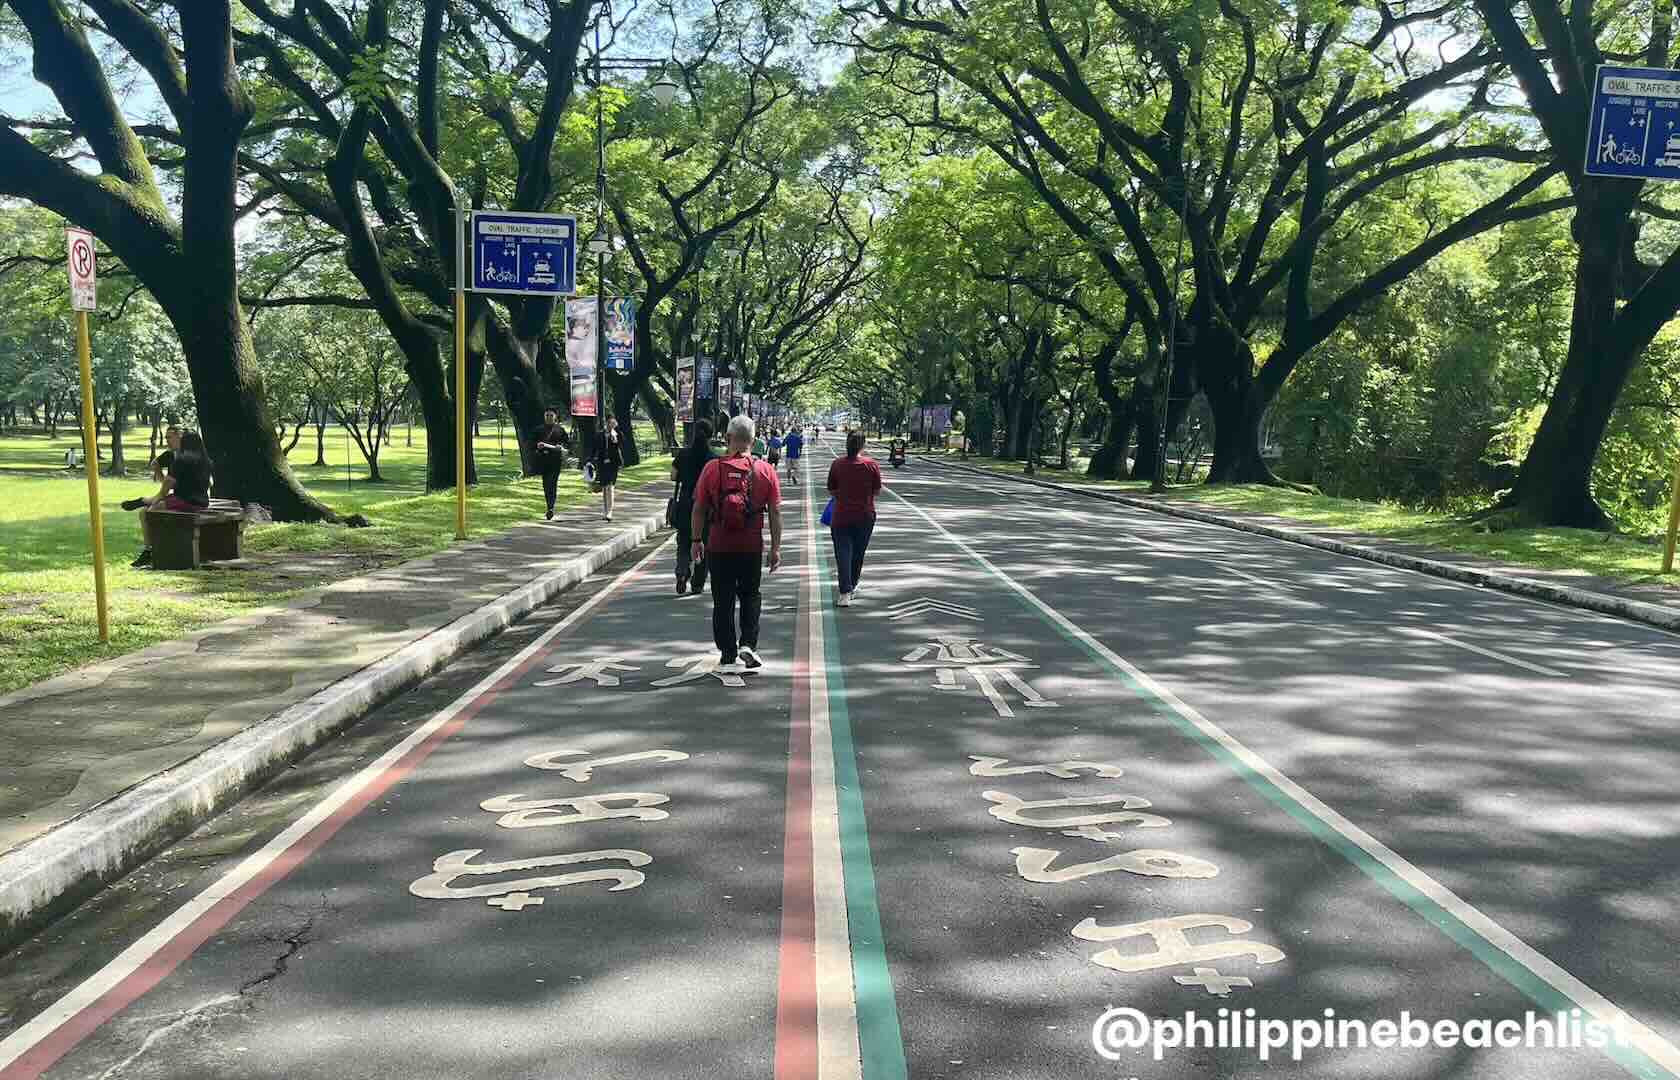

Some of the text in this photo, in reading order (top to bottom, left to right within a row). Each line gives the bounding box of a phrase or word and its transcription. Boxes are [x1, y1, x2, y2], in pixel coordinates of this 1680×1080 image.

[1608, 81, 1629, 90] OVAL
[1635, 83, 1672, 94] TRAFFIC
[488, 224, 504, 232] OVAL
